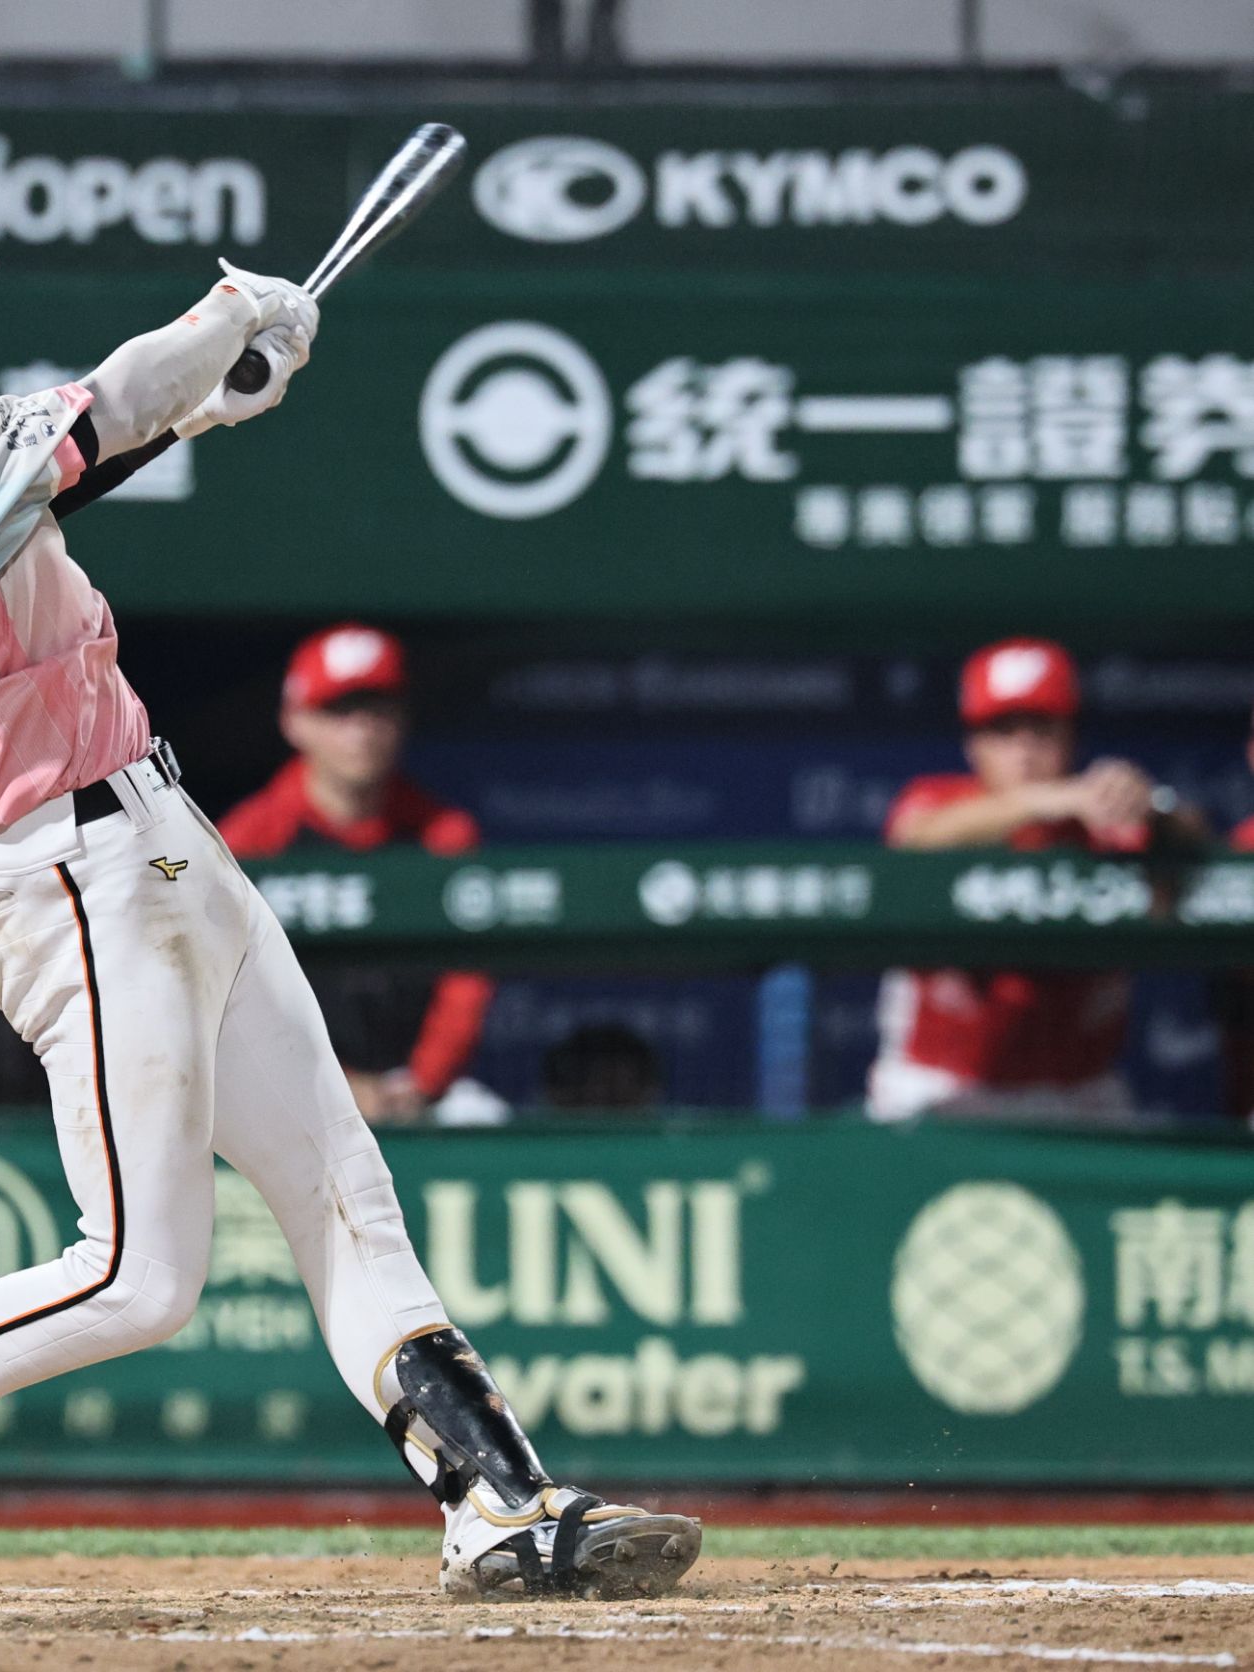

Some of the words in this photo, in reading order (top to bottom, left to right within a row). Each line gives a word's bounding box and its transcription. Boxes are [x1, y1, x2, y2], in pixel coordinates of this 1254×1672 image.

[654, 145, 1027, 227] KYMCO
[423, 1180, 742, 1327] UNI
[1109, 1197, 1254, 1330] 南
